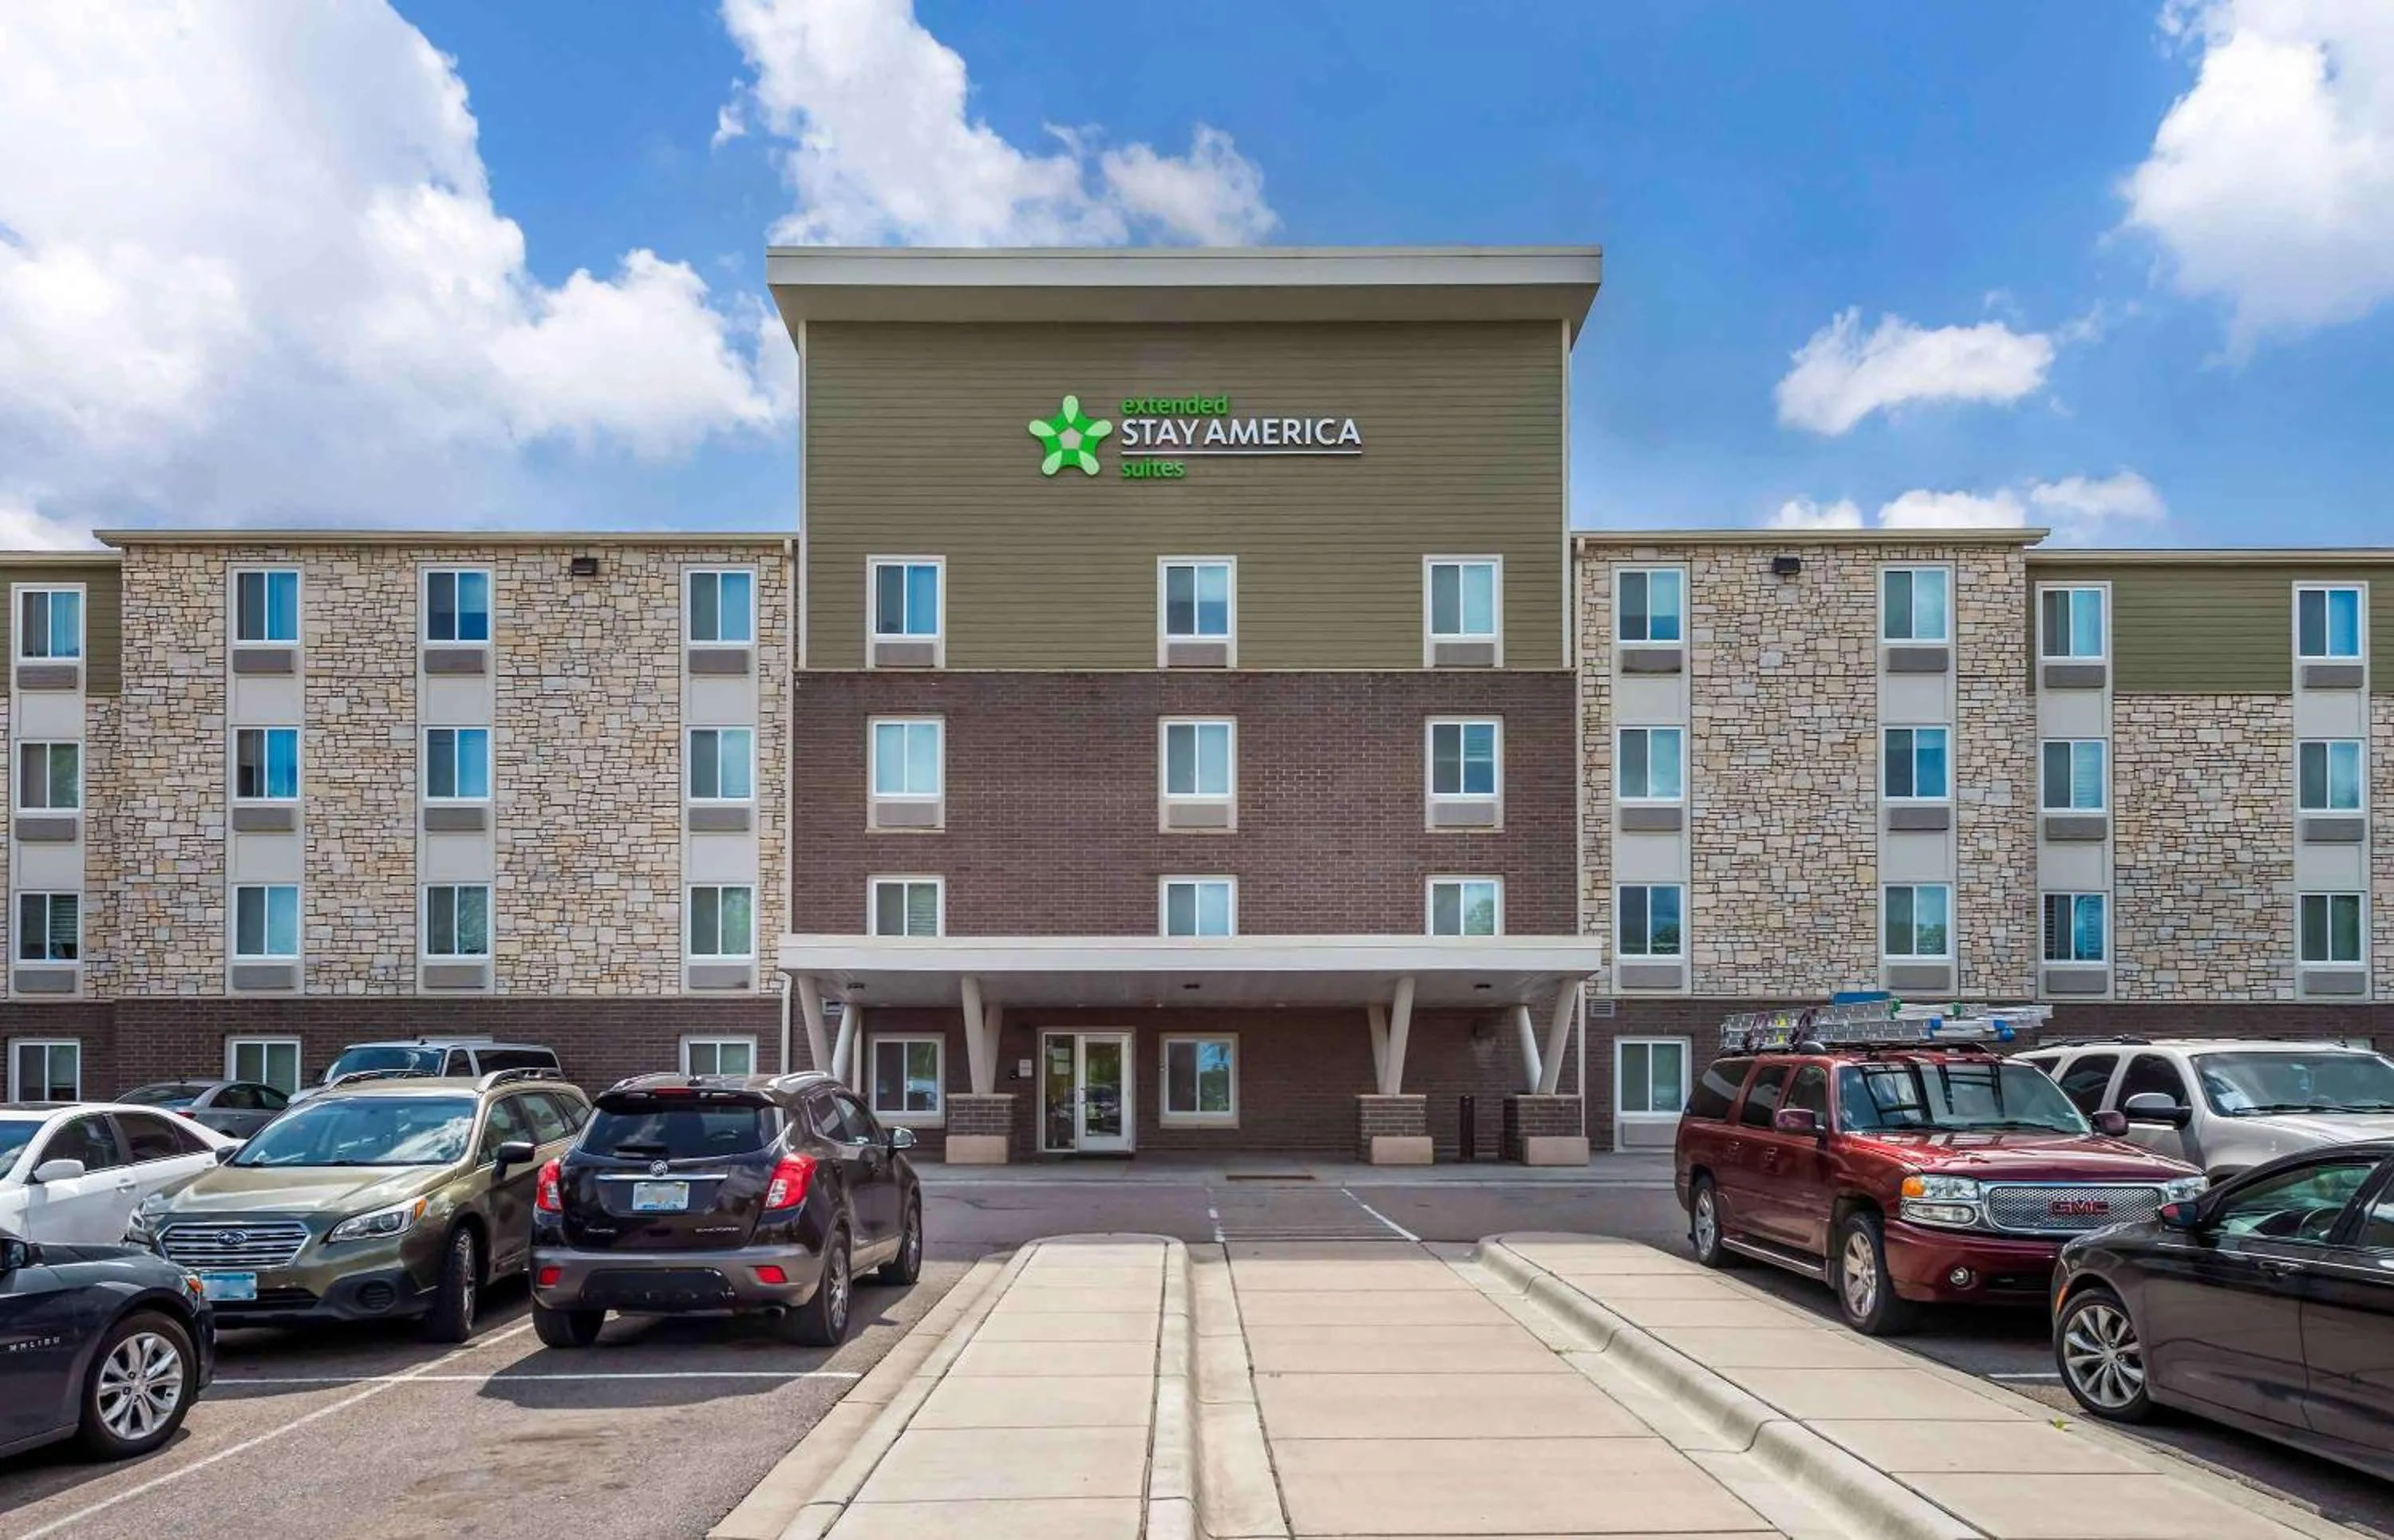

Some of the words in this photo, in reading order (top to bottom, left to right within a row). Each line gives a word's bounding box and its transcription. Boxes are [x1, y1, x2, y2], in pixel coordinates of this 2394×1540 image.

[1121, 396, 1227, 415] extended
[1121, 418, 1199, 445] STAY
[1204, 418, 1362, 445] AMERICA
[1121, 458, 1185, 477] suites
[2052, 1201, 2109, 1214] GMC
